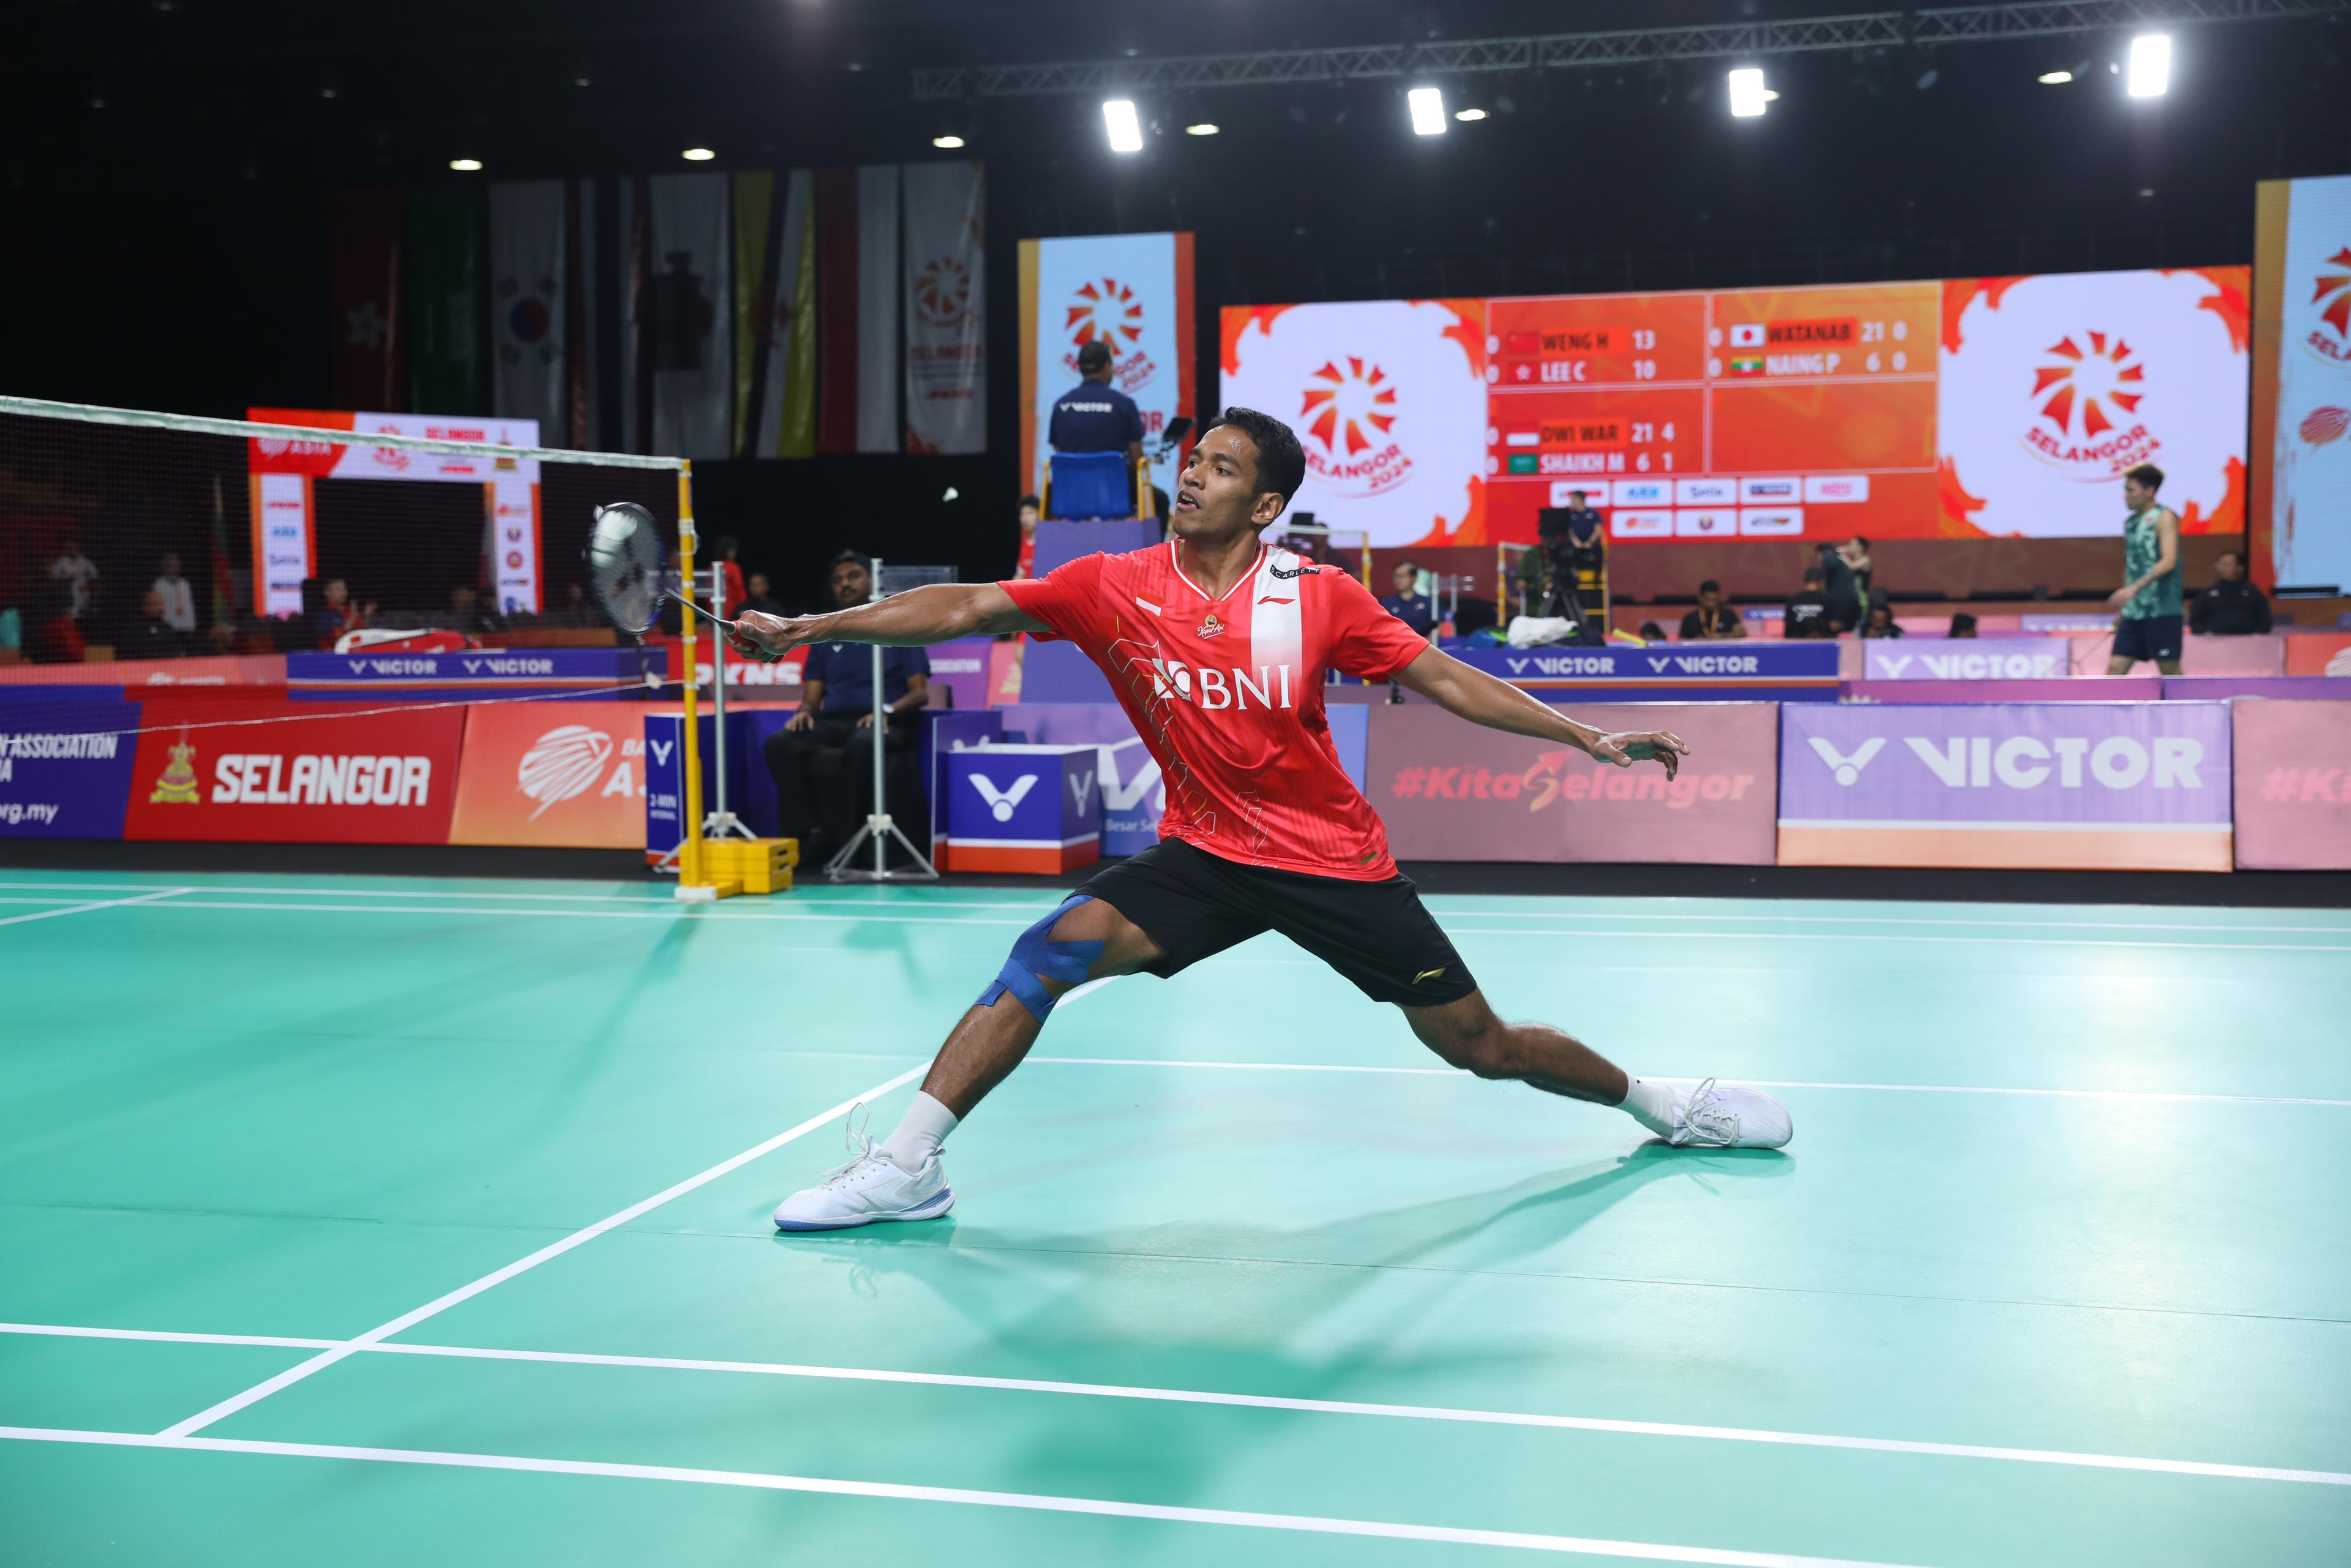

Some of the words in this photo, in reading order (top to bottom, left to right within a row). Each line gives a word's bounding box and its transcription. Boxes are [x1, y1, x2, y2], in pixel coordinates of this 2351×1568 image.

[1542, 333, 1592, 351] WENG
[1633, 329, 1655, 350] 13
[1861, 321, 1884, 342] 21
[1893, 320, 1907, 341] 0
[1541, 361, 1571, 383] LEE
[1573, 361, 1586, 381] C
[1632, 359, 1656, 380] 10
[1866, 352, 1881, 372] 6
[1892, 351, 1907, 372] 0
[1631, 422, 1653, 443] 21
[1662, 422, 1675, 441] 4
[2025, 425, 2149, 463] SELANGOR
[1540, 453, 1605, 473] SHAIKH
[1636, 452, 1650, 472] 6
[1662, 452, 1673, 471] 1
[1270, 567, 1320, 579] SCARLETT
[370, 659, 438, 675] VICTOR
[486, 658, 553, 674] VICTOR
[1534, 657, 1615, 675] VICTOR
[1674, 656, 1758, 673] VICTOR
[1919, 654, 2056, 679] VICTOR
[1198, 664, 1291, 710] BNI
[9, 733, 118, 759] ASSOCIATION
[1905, 737, 2203, 789] VICTOR
[212, 754, 431, 806] SELANGOR
